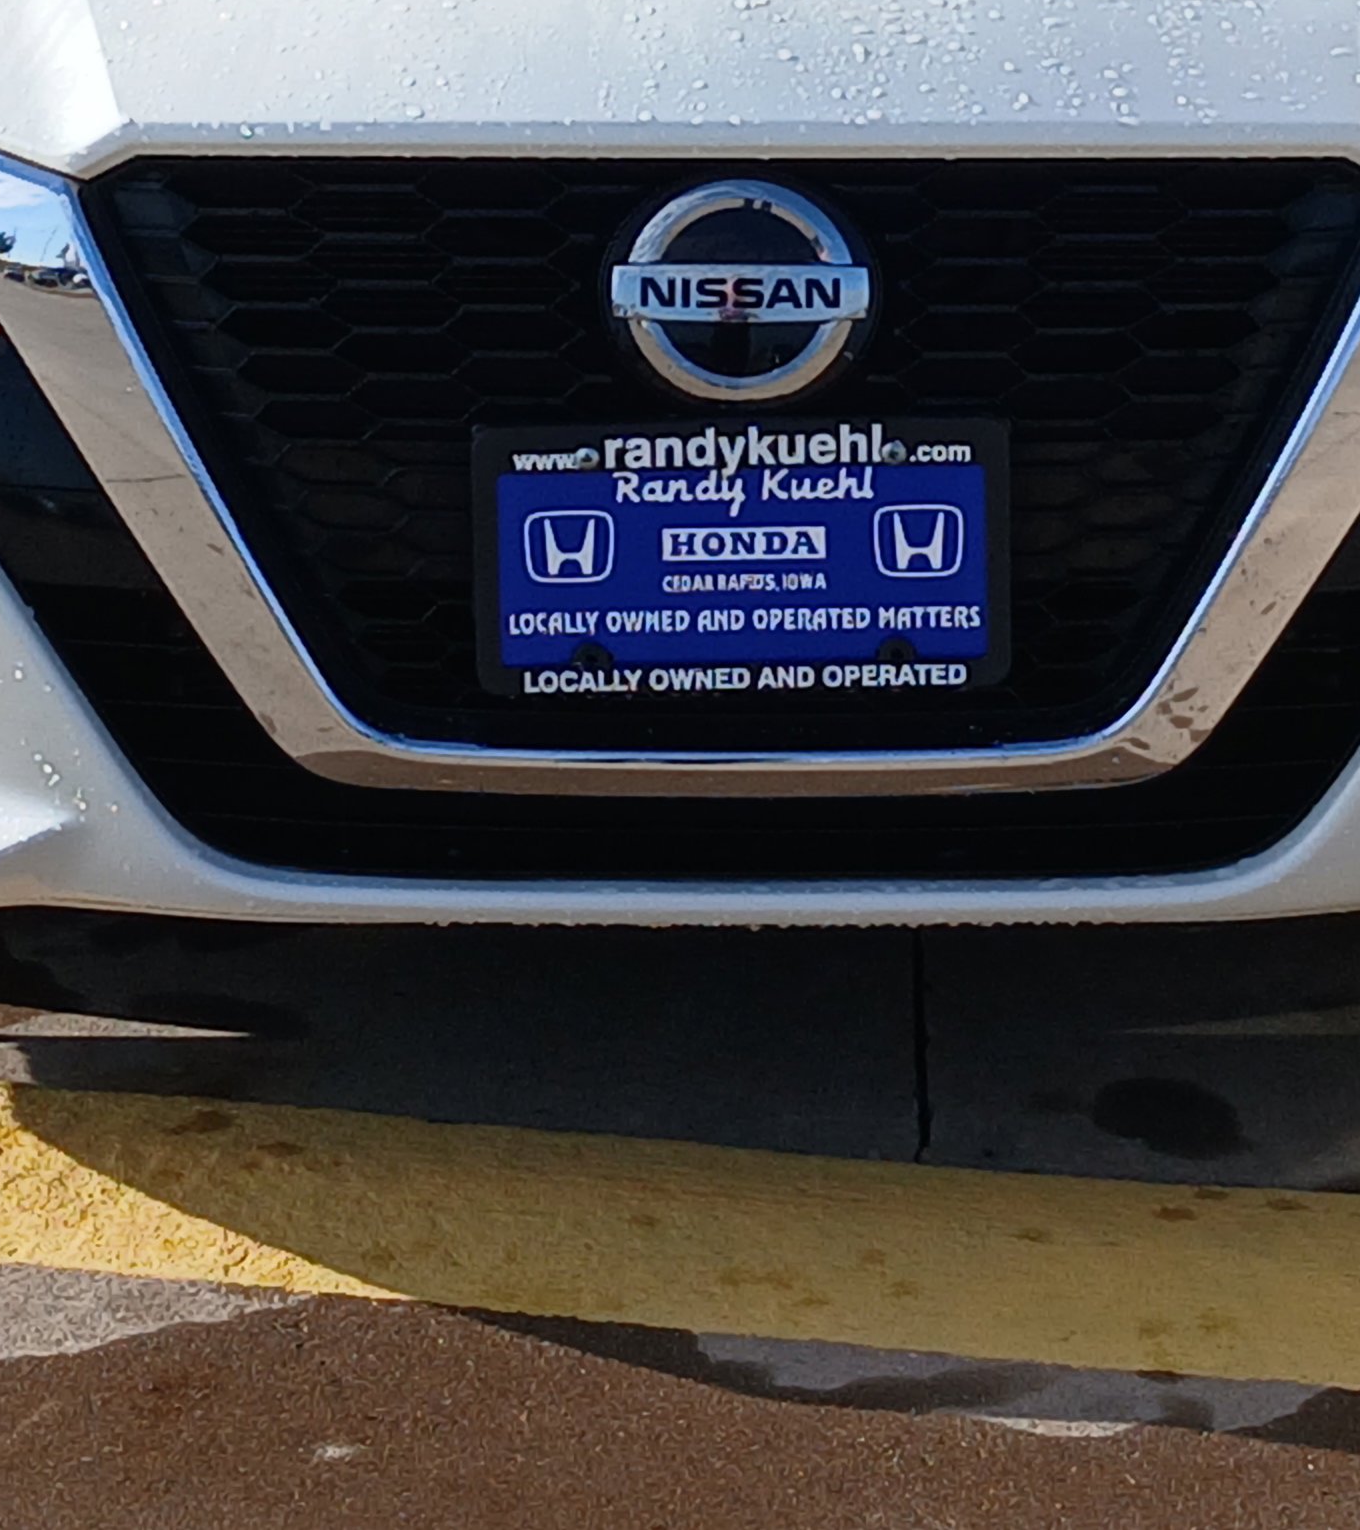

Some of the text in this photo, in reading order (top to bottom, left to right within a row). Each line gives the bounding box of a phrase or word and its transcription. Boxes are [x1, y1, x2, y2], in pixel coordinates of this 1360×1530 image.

[640, 276, 841, 308] NISSAN
[612, 466, 875, 517] Randy Kuehl
[669, 530, 820, 557] HONDA
[782, 572, 827, 591] IOWA
[508, 605, 981, 635] LOCALLY OWNED AND OPERATED MATTERS
[523, 663, 968, 695] LOCALLY OWNED AND OPERATED
